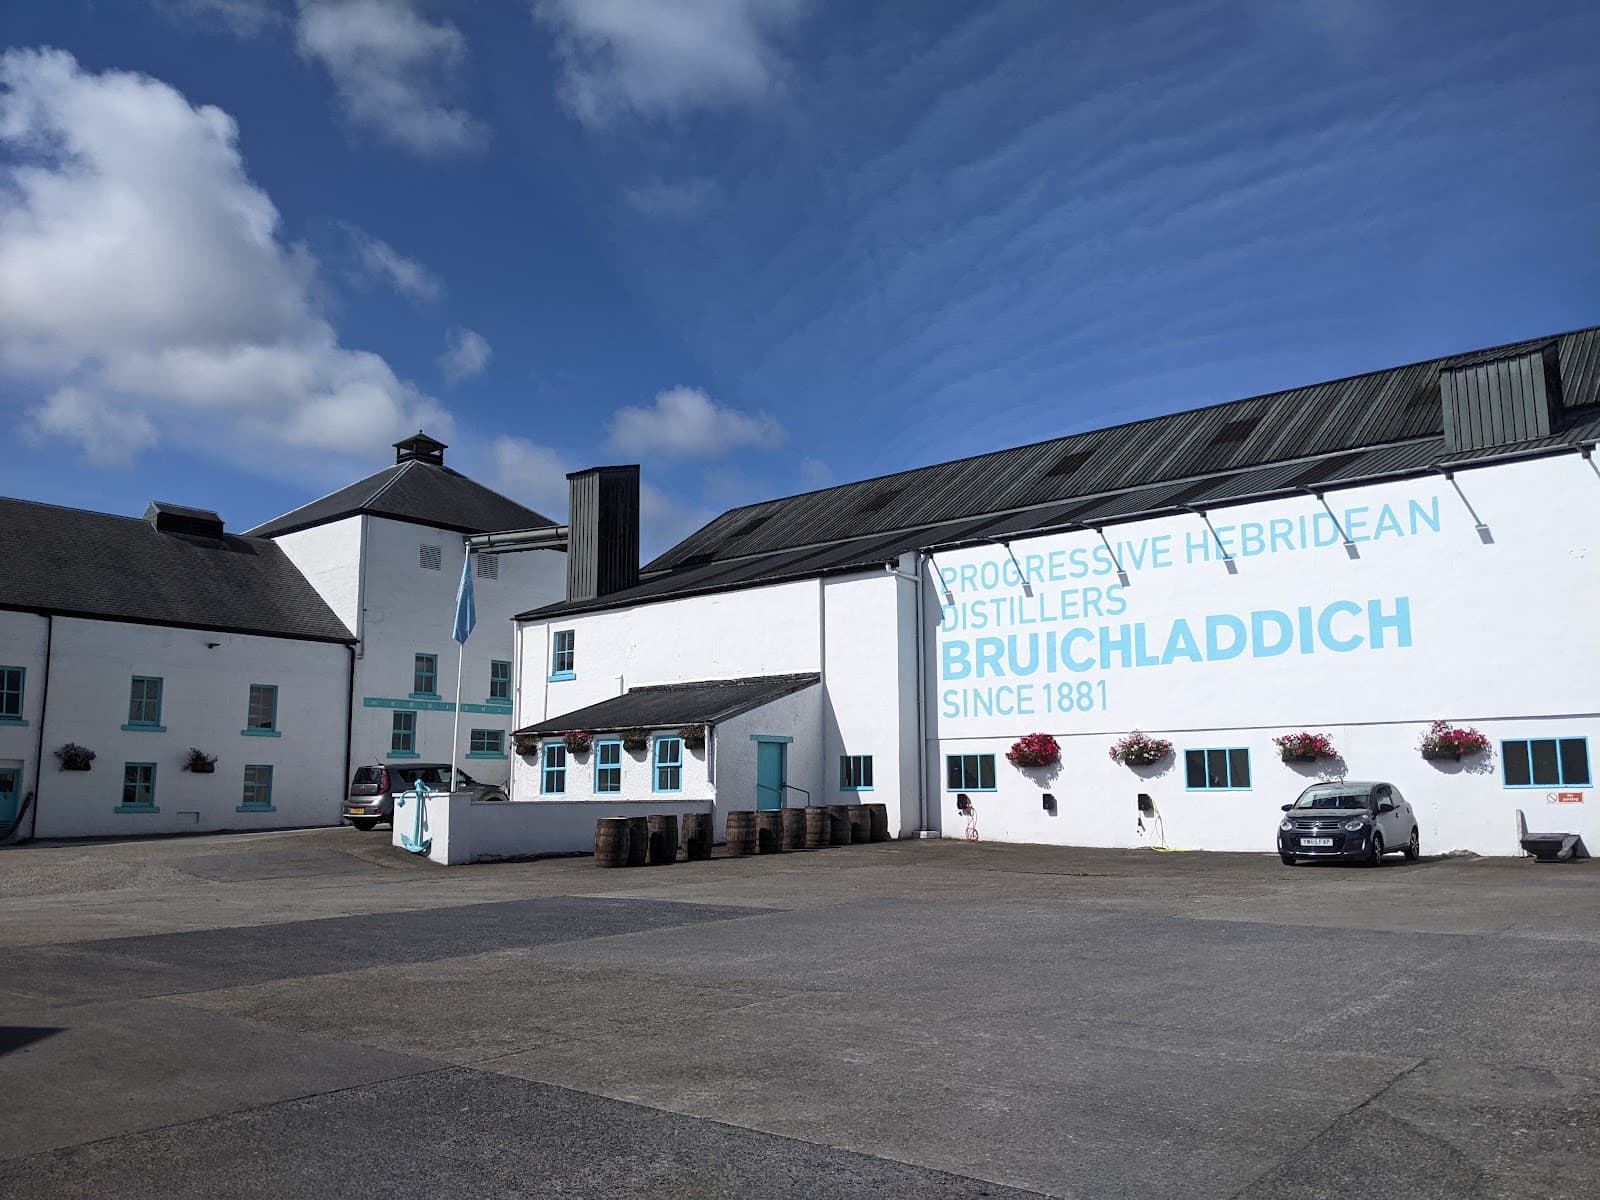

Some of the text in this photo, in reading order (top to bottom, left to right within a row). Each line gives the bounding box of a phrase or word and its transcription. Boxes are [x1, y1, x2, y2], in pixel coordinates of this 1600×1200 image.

[940, 496, 1441, 595] PROGRESSIVE HEBRIDEAN
[941, 584, 1128, 633] DISTILLERS
[942, 596, 1413, 680] BRUICHLADDICH
[943, 679, 1107, 719] SINCE 1881
